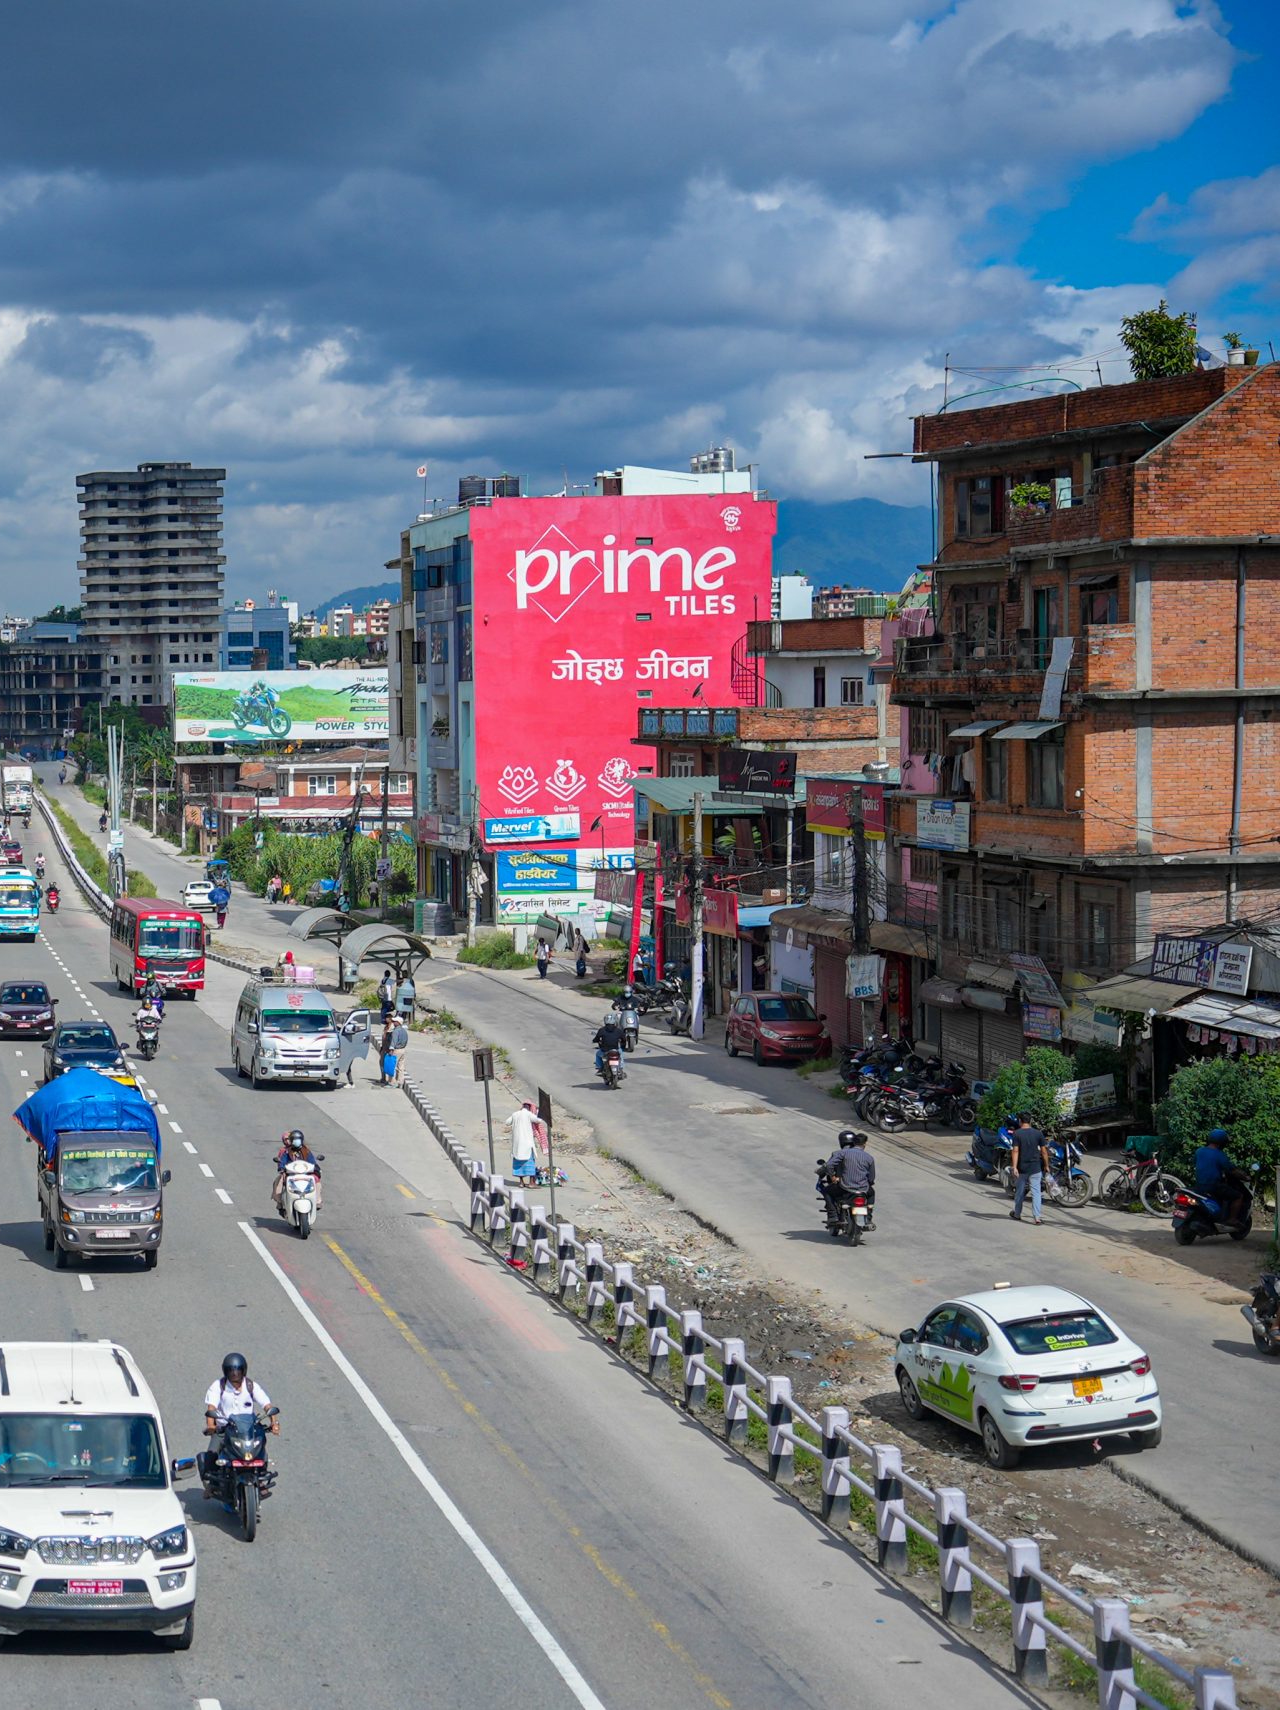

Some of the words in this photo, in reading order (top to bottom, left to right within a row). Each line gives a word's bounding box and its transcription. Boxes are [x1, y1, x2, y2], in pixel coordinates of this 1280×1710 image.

[515, 534, 737, 609] prime
[664, 594, 736, 616] TILES
[551, 649, 624, 686] जोड्छ
[635, 648, 713, 680] जीवन
[333, 683, 389, 697] Apach
[315, 722, 355, 731] POWER
[363, 722, 389, 731] STYL
[568, 803, 580, 812] Tiles
[491, 821, 532, 833] Marvel
[1155, 939, 1202, 968] XTREME
[1177, 966, 1198, 983] DRINK
[854, 985, 874, 996] BBS
